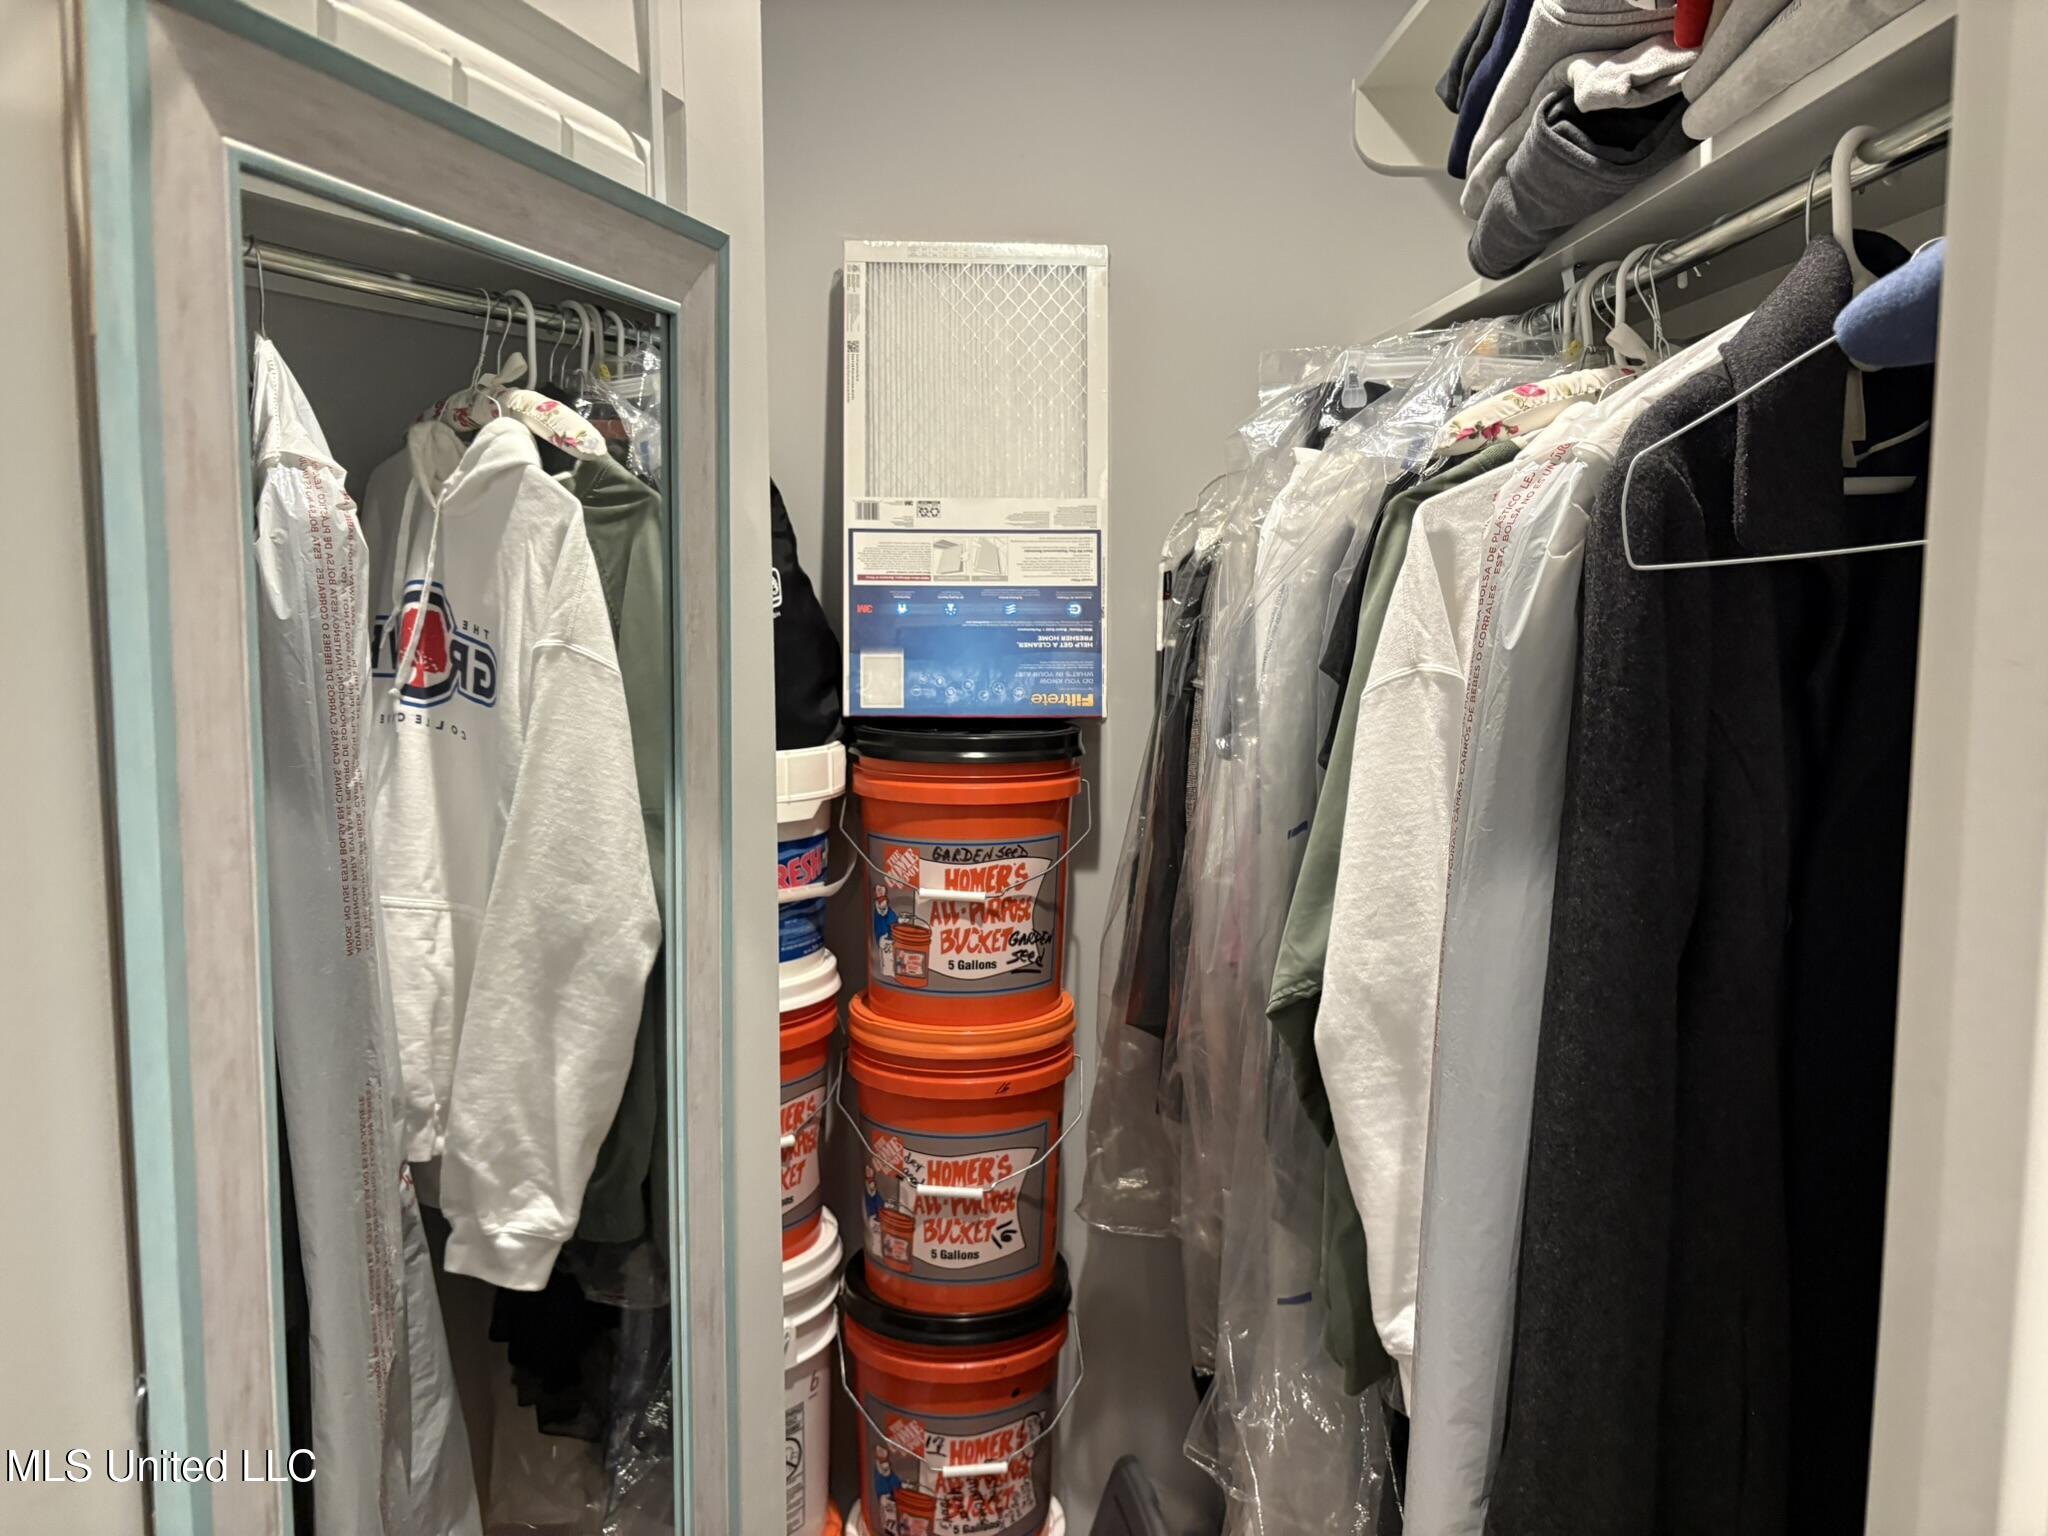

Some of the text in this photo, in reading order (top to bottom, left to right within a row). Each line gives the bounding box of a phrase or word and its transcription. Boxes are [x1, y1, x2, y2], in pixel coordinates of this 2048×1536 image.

[1542, 463, 1558, 476] UN
[1520, 491, 1536, 505] NO
[1491, 494, 1520, 543] PLÁSTICO
[1502, 506, 1525, 542] BOLSA
[1486, 546, 1498, 562] DE
[1494, 547, 1505, 575] ESTA
[856, 604, 873, 614] 3M
[1469, 665, 1481, 703] BEBES
[1031, 693, 1094, 707] Filtrete
[1466, 707, 1475, 722] DE
[932, 846, 994, 863] GARDEN
[944, 862, 1028, 892] HOMER'S
[940, 926, 1015, 955] BUCKET
[1009, 929, 1054, 947] GARDEN
[948, 961, 997, 971] 5 Gallons
[927, 1154, 1013, 1186] HOMER'S
[923, 1217, 998, 1245] BUCKET
[931, 1249, 980, 1260] 5 Gallons
[953, 1525, 959, 1534] 5
